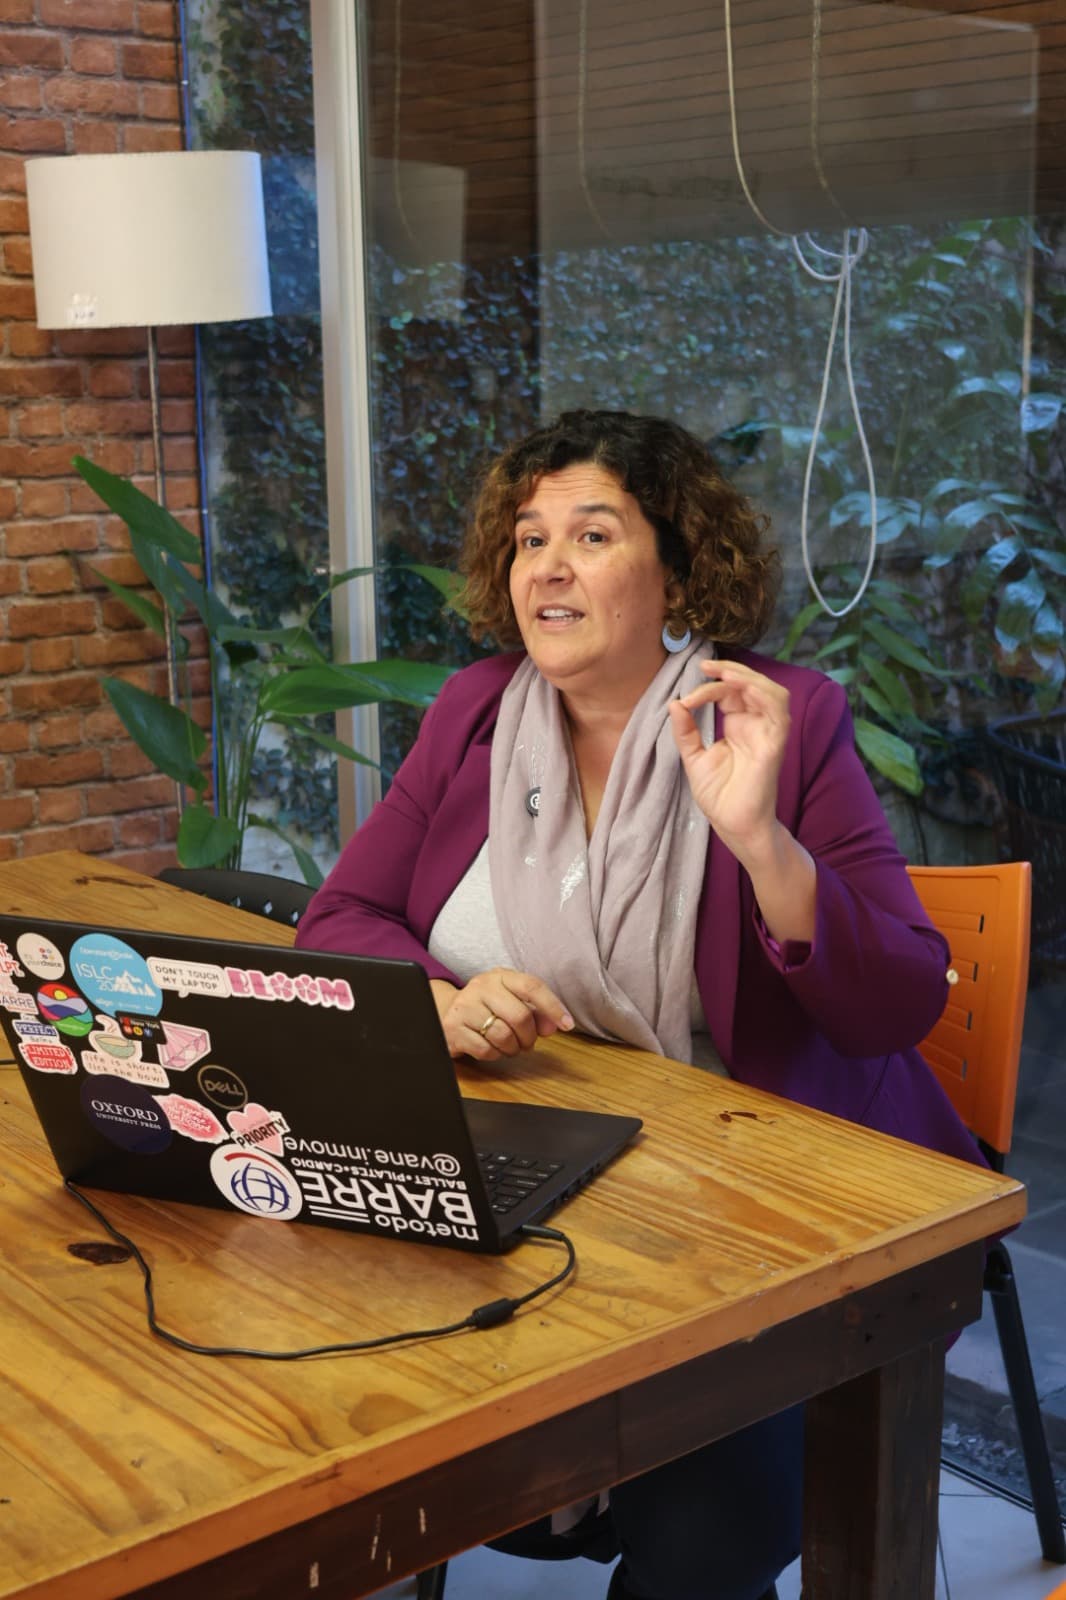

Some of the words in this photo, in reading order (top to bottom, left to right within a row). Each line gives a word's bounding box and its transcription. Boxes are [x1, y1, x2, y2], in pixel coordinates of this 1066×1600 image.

[76, 962, 114, 980] ISLC
[155, 965, 183, 975] DON'T
[188, 970, 220, 980] TOUCH
[162, 976, 177, 985] MY
[181, 979, 217, 990] LAPTOP
[226, 969, 352, 1009] BLOOM
[26, 1045, 67, 1058] LIMITED
[32, 1057, 71, 1069] EDITION
[205, 1080, 244, 1096] DELL
[91, 1099, 160, 1122] OXFORD
[96, 1112, 138, 1126] UNIVERSITY
[141, 1121, 162, 1131] PRESS
[236, 1118, 287, 1149] PRIORITY
[284, 1136, 461, 1177] @vane.inmove
[415, 1173, 467, 1191] BALLET
[295, 1169, 478, 1226] BARRE
[374, 1213, 480, 1241] metodo
